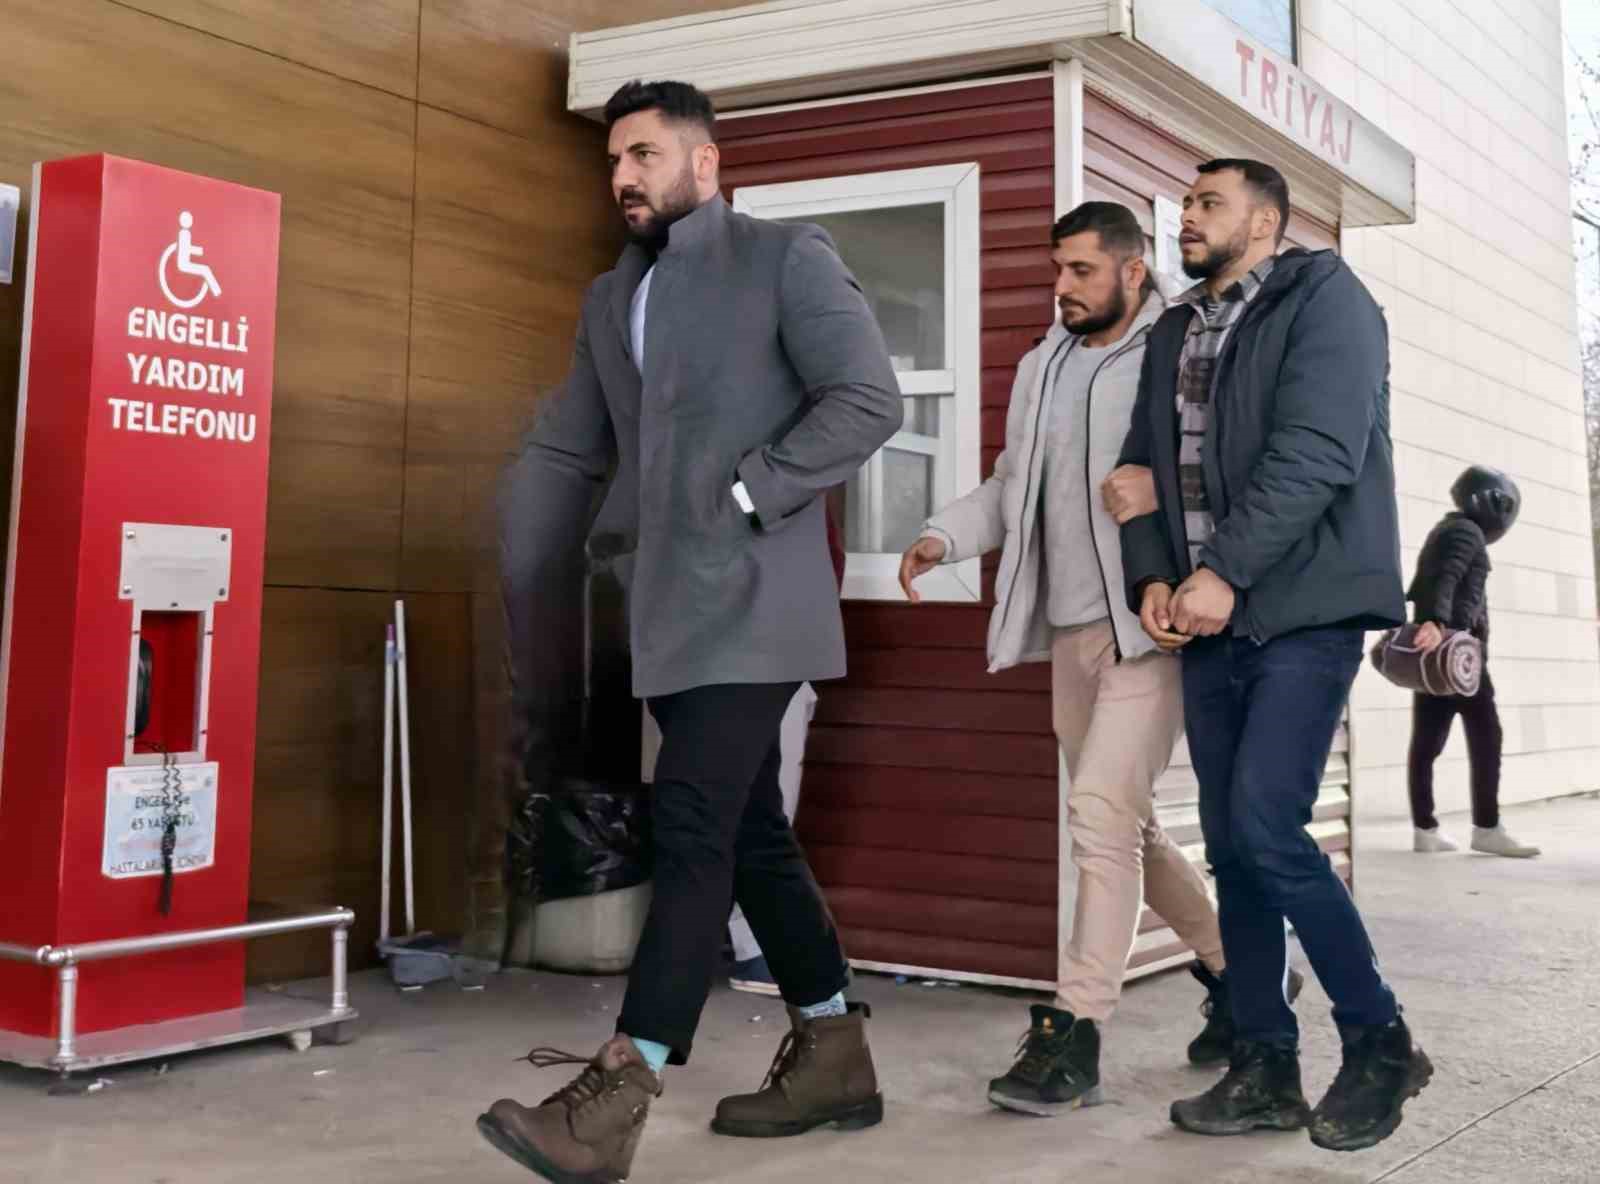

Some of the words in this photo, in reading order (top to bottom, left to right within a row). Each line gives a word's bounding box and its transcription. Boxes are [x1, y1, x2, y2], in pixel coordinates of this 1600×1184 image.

[128, 307, 249, 352] ENGELLİ
[127, 353, 244, 396] YARDIM
[108, 398, 256, 442] TELEFONU
